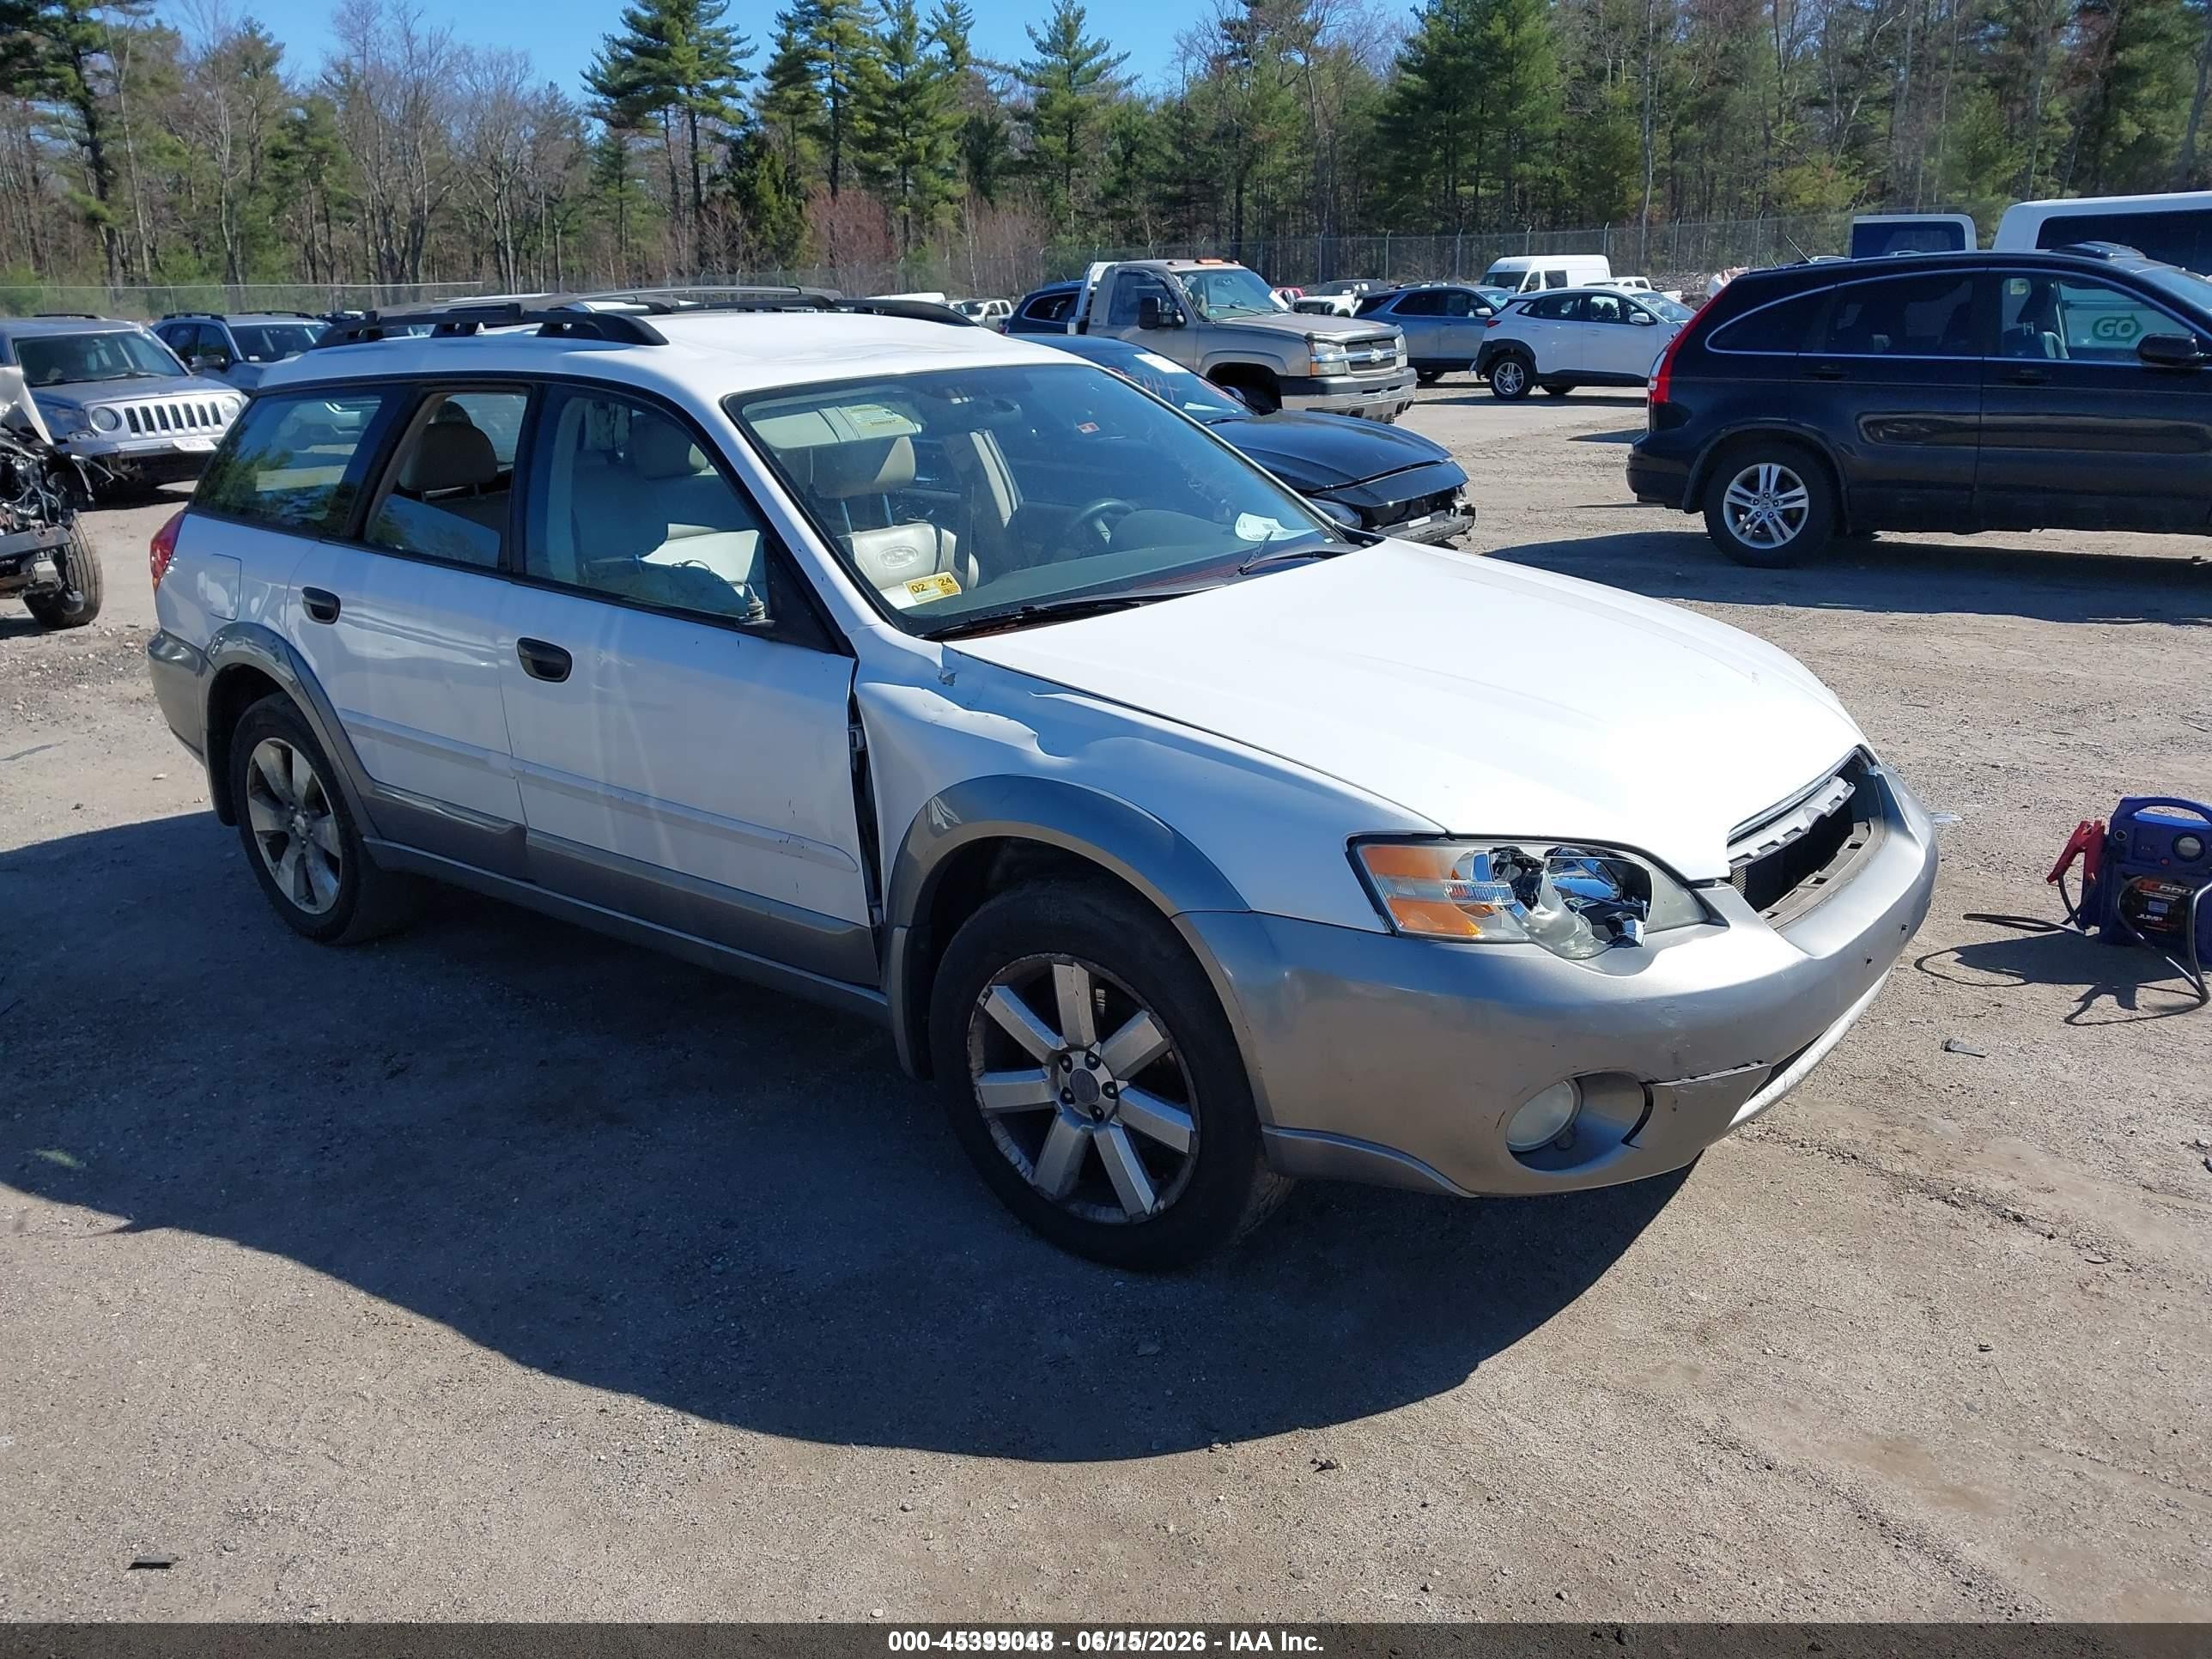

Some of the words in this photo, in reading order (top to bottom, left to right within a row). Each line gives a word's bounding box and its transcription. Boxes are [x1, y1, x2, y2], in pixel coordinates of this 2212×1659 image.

[2097, 319, 2136, 337] GO
[911, 583, 927, 592] 02
[938, 576, 953, 586] 24
